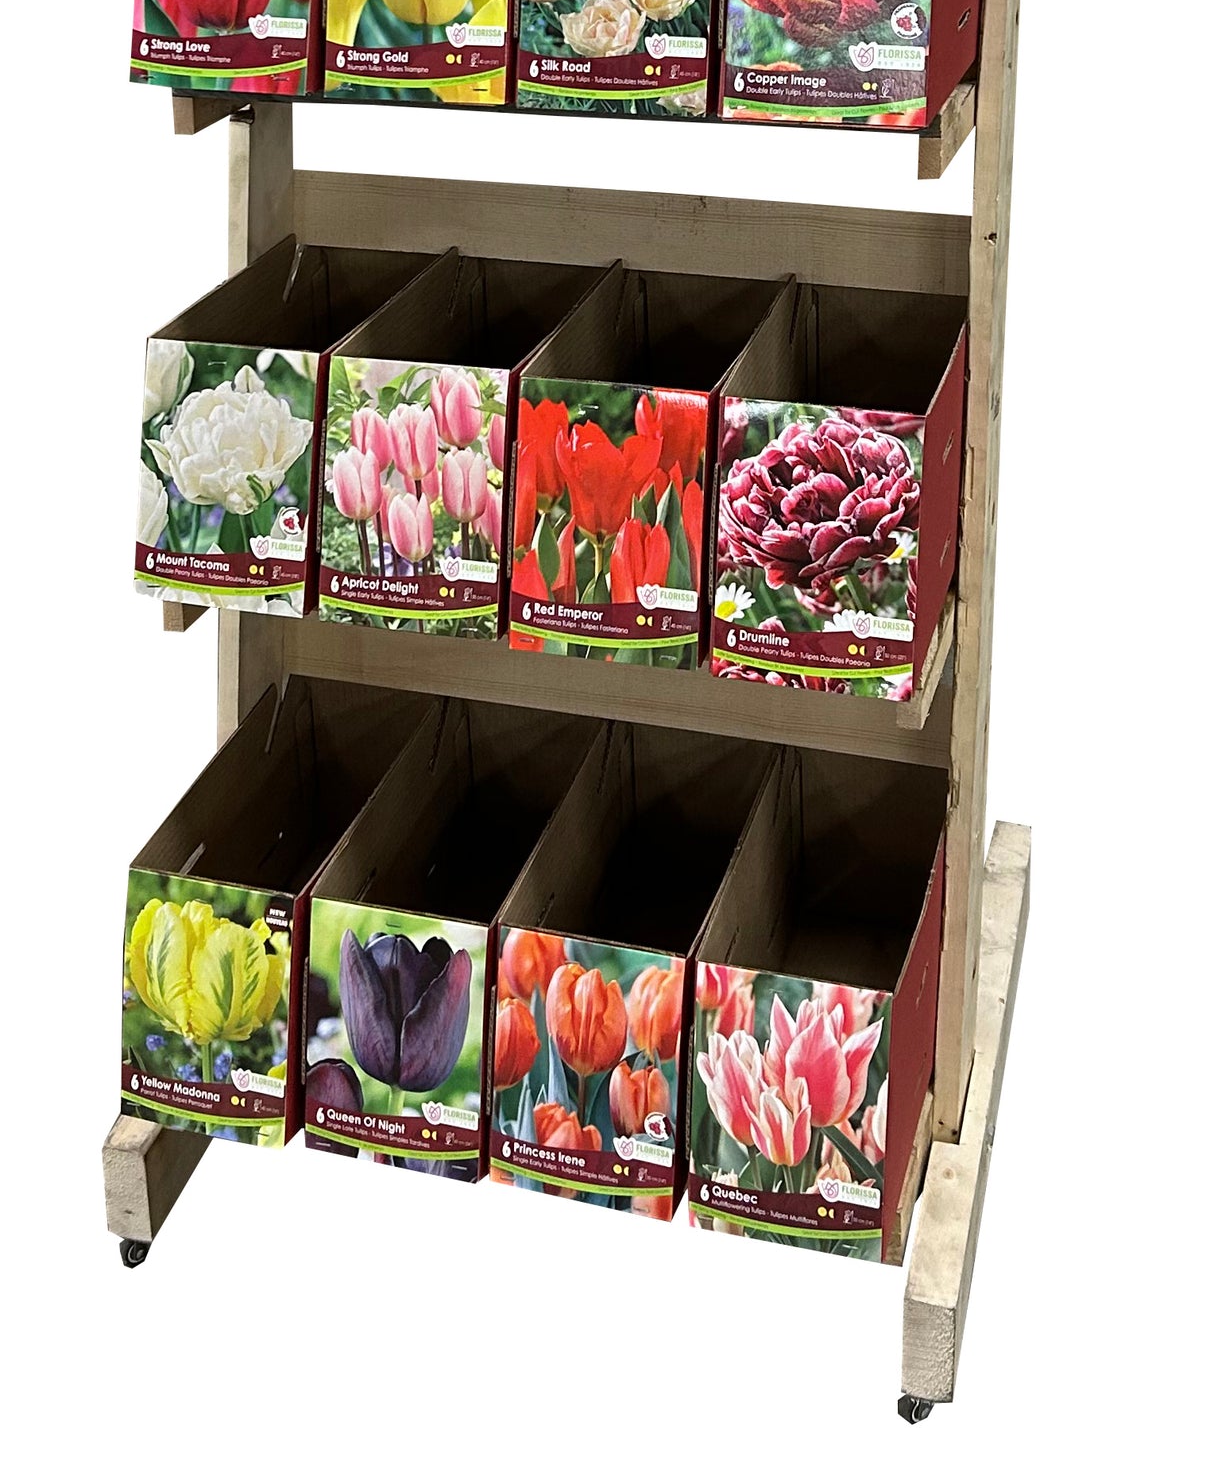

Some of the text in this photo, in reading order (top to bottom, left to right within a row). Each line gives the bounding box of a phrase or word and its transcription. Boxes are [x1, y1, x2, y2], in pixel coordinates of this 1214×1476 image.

[468, 29, 501, 37] FLORISSA
[140, 39, 210, 56] 6 Strong Love
[669, 40, 703, 48] FLORISSA
[336, 50, 408, 68] 6 Strong Gold
[878, 49, 921, 60] FLORISSA
[530, 59, 590, 77] 6 Silk Road
[562, 75, 575, 83] Early
[734, 72, 826, 92] 6 Copper Image
[746, 86, 768, 94] Double
[770, 88, 784, 96] Early
[785, 88, 801, 96] Tulips
[272, 543, 302, 552] FLORISSA
[146, 552, 229, 572] 6 Mount Tacoma
[462, 563, 494, 572] FLORISSA
[331, 576, 419, 595] 6 Apricot Delight
[660, 591, 694, 602] FLORISSA
[522, 602, 603, 621] 6 Red Emperor
[562, 619, 577, 628] Tulips
[581, 622, 599, 630] Tulipes
[873, 620, 910, 632] FLORISSA
[727, 629, 790, 647] 6 Drumline
[738, 644, 759, 653] Double
[761, 646, 779, 656] Peony
[780, 649, 795, 658] Tulips
[800, 652, 819, 661] Tulipes
[820, 655, 844, 664] Doubles
[131, 1074, 221, 1102] 6 Yellow Madonna
[316, 1108, 405, 1134] 6 Queen Of Night
[443, 1109, 475, 1122] FLORISSA
[502, 1141, 585, 1167] 6 Princess Irene
[636, 1145, 669, 1158] FLORISSA
[700, 1184, 758, 1204] 6 Quebec
[842, 1185, 878, 1199] FLORISSA
[751, 1205, 766, 1215] Tulips
[770, 1209, 789, 1220] Tulipes
